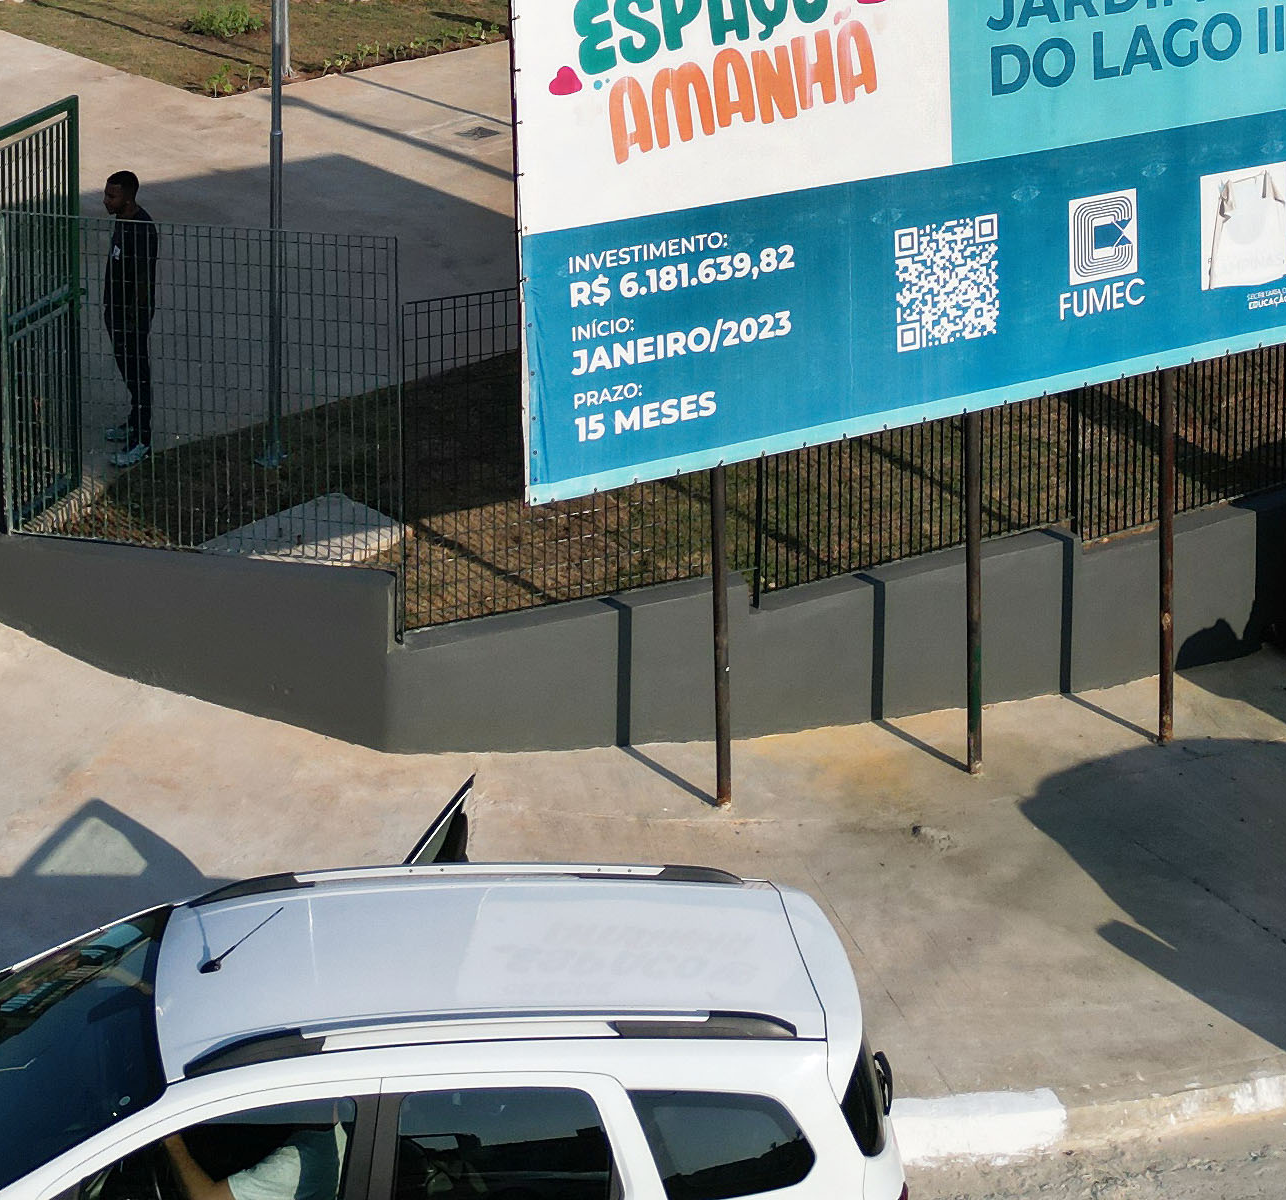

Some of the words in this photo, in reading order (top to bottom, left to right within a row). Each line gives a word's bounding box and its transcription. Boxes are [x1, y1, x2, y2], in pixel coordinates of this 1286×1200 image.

[991, 37, 1076, 96] DO
[1093, 12, 1242, 80] LAGO
[1258, 4, 1284, 54] II
[609, 6, 878, 165] AMANHÃ
[568, 231, 728, 274] INVESTIMENTO:
[570, 274, 611, 307] R$
[619, 244, 796, 298] 6.181.639,82
[1059, 278, 1146, 320] FUMEC
[571, 317, 635, 342] INÍCIO:
[571, 310, 792, 376] JANEIRO/2023
[573, 382, 643, 409] PRAZO:
[575, 413, 605, 442] 15
[614, 391, 717, 435] MESES
